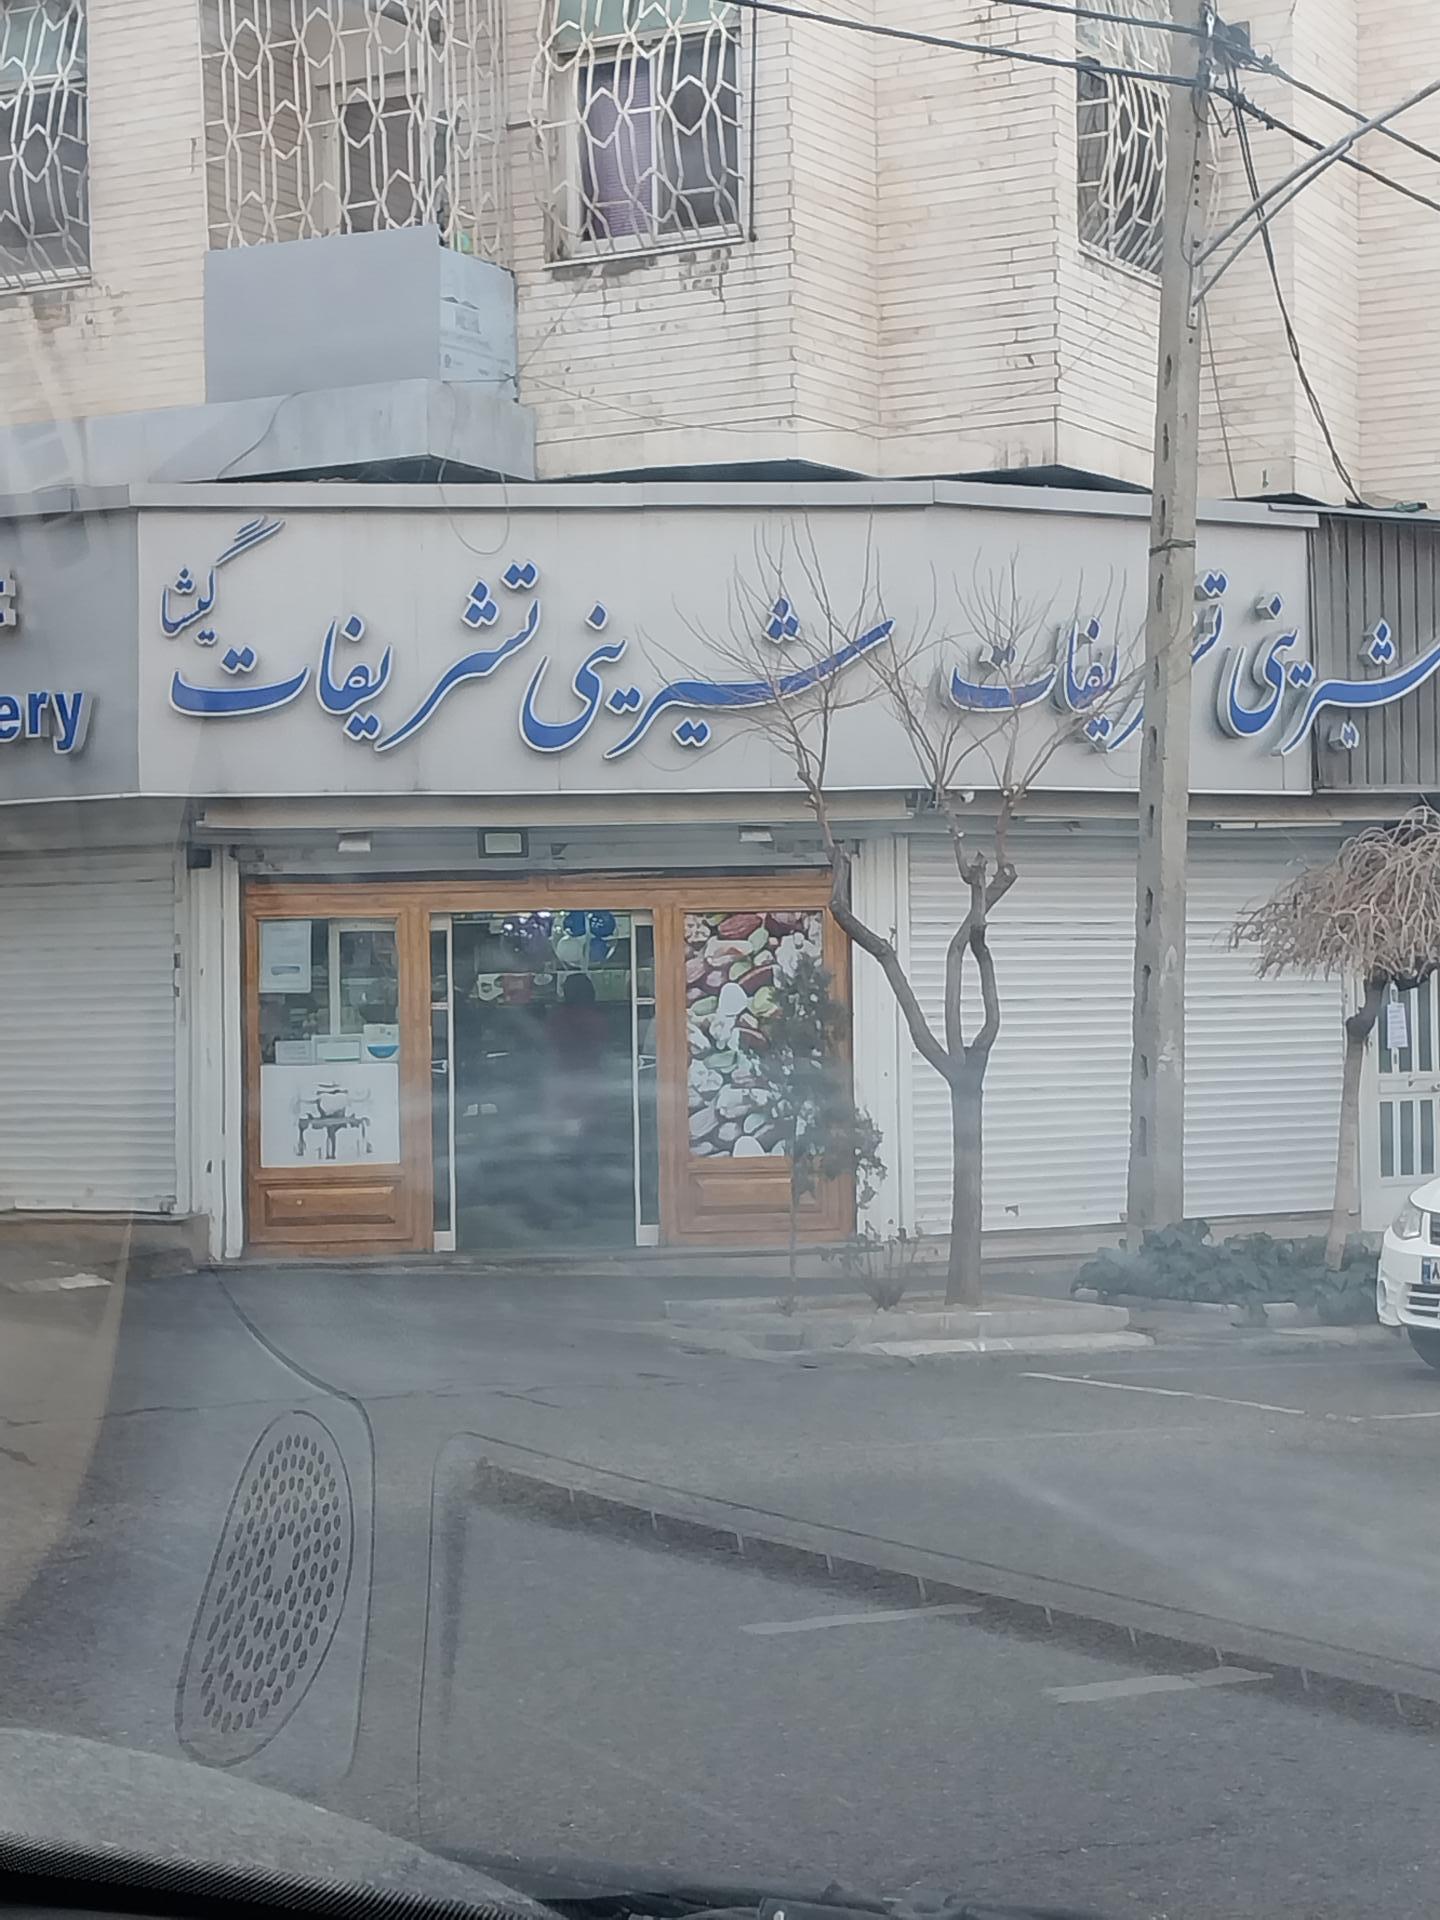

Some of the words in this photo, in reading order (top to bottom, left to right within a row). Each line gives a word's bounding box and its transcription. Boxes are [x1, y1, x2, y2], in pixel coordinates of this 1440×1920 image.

[161, 515, 286, 639] گیشا
[169, 558, 540, 752] تشریفات
[519, 598, 896, 759] شیرینی
